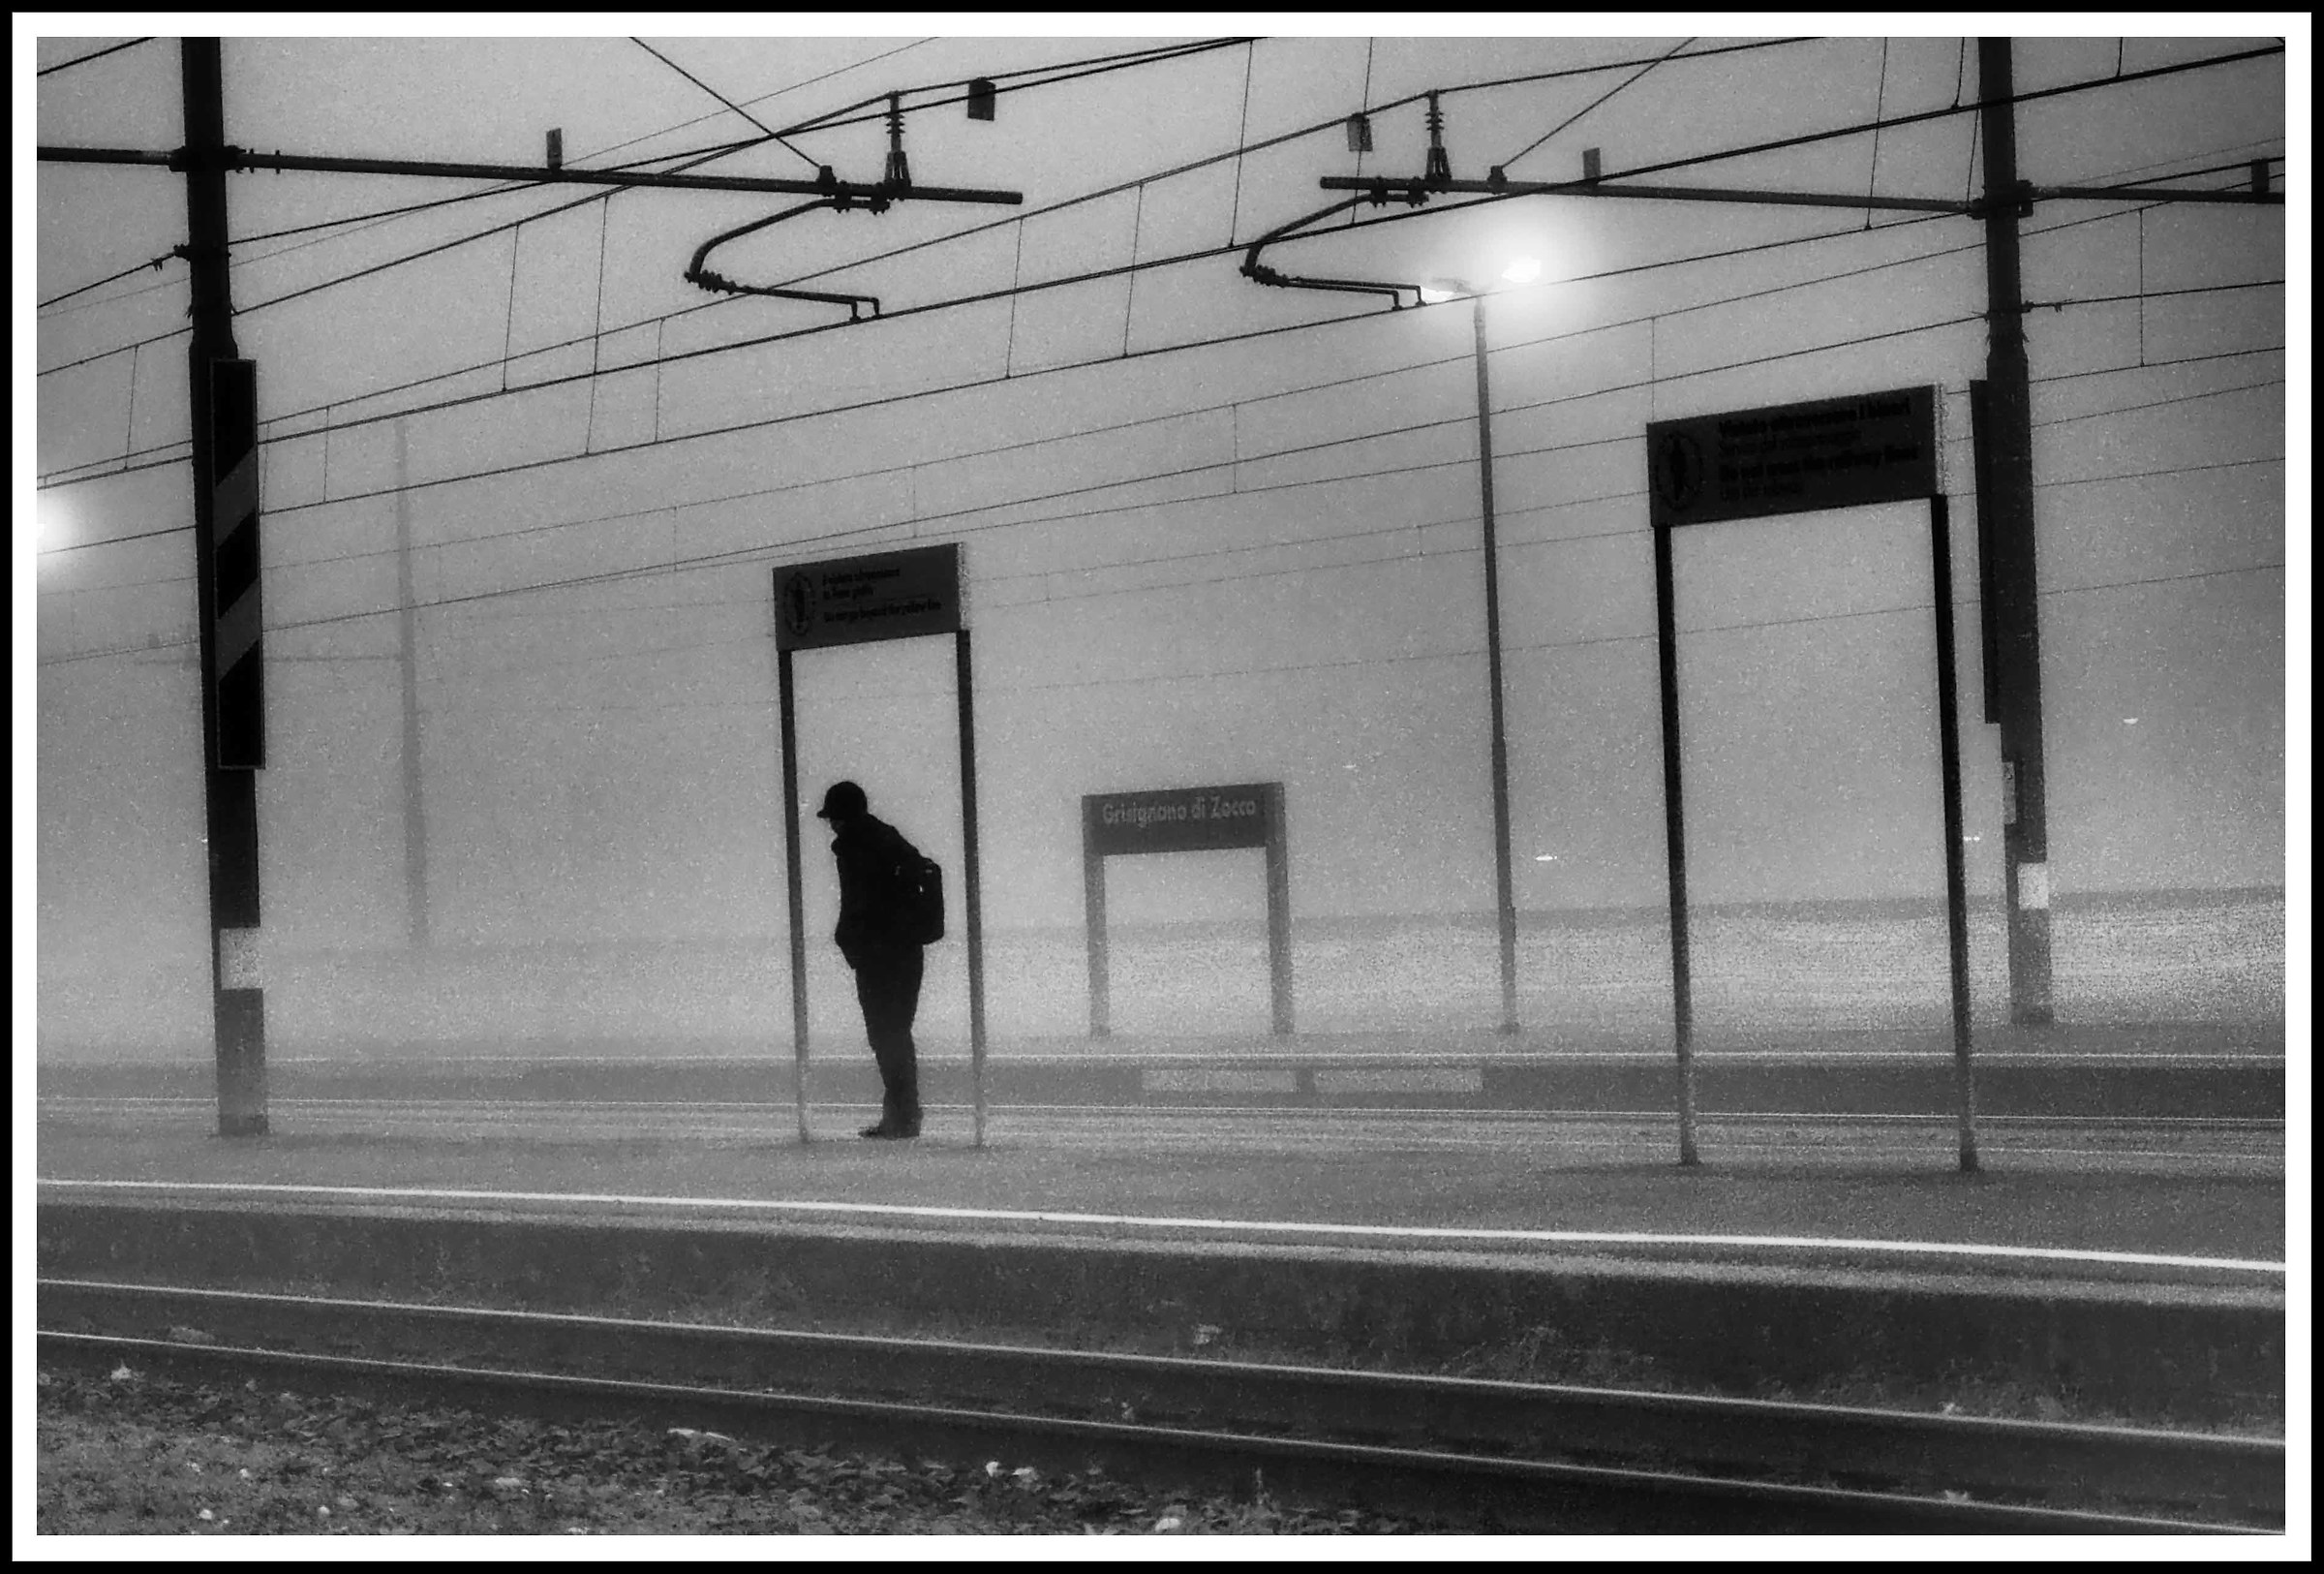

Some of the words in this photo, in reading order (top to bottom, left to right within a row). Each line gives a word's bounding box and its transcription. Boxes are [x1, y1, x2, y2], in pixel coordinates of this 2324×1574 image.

[1103, 801, 1187, 829] Grisignano
[1191, 795, 1205, 819] di
[1209, 794, 1256, 819] Zocco
